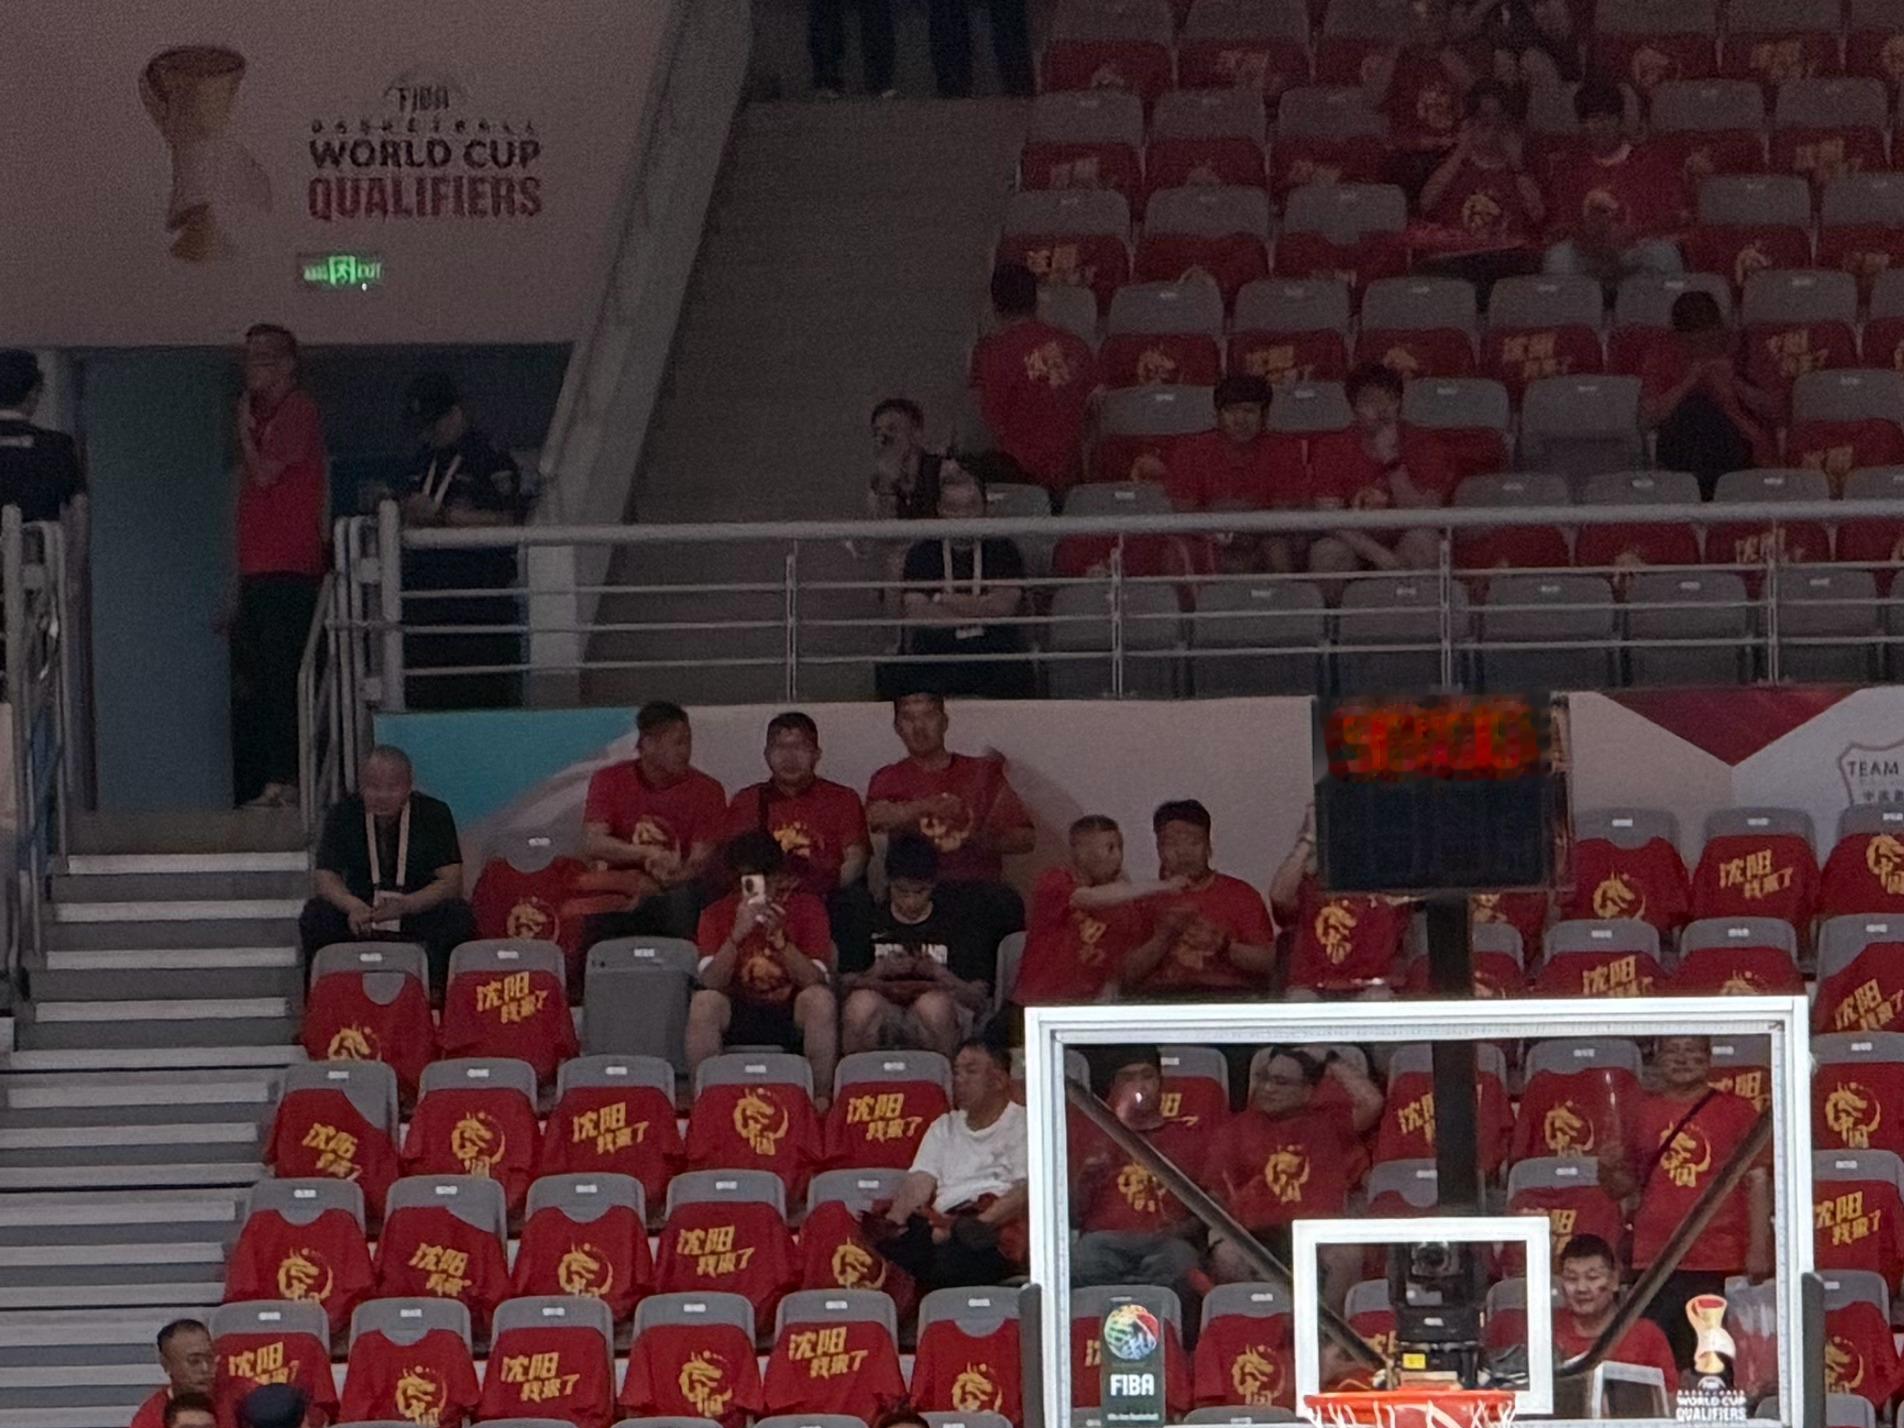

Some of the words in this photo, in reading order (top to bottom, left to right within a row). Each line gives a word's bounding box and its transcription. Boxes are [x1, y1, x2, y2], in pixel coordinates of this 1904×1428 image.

[308, 138, 452, 169] WORLD
[462, 138, 542, 169] CUP
[307, 175, 543, 222] QUALIFIERS
[1847, 760, 1899, 777] TEAM
[573, 1102, 625, 1142] 沈阳
[847, 1093, 904, 1123] 沈阳
[677, 1225, 735, 1255] 沈阳
[789, 1325, 847, 1360] 沈阳
[501, 1352, 559, 1382] 沈阳
[1110, 1373, 1155, 1396] FIBA
[1676, 1407, 1747, 1422] QUALIFIERS
[1677, 1395, 1720, 1406] WORLD
[1721, 1395, 1747, 1406] CUP
